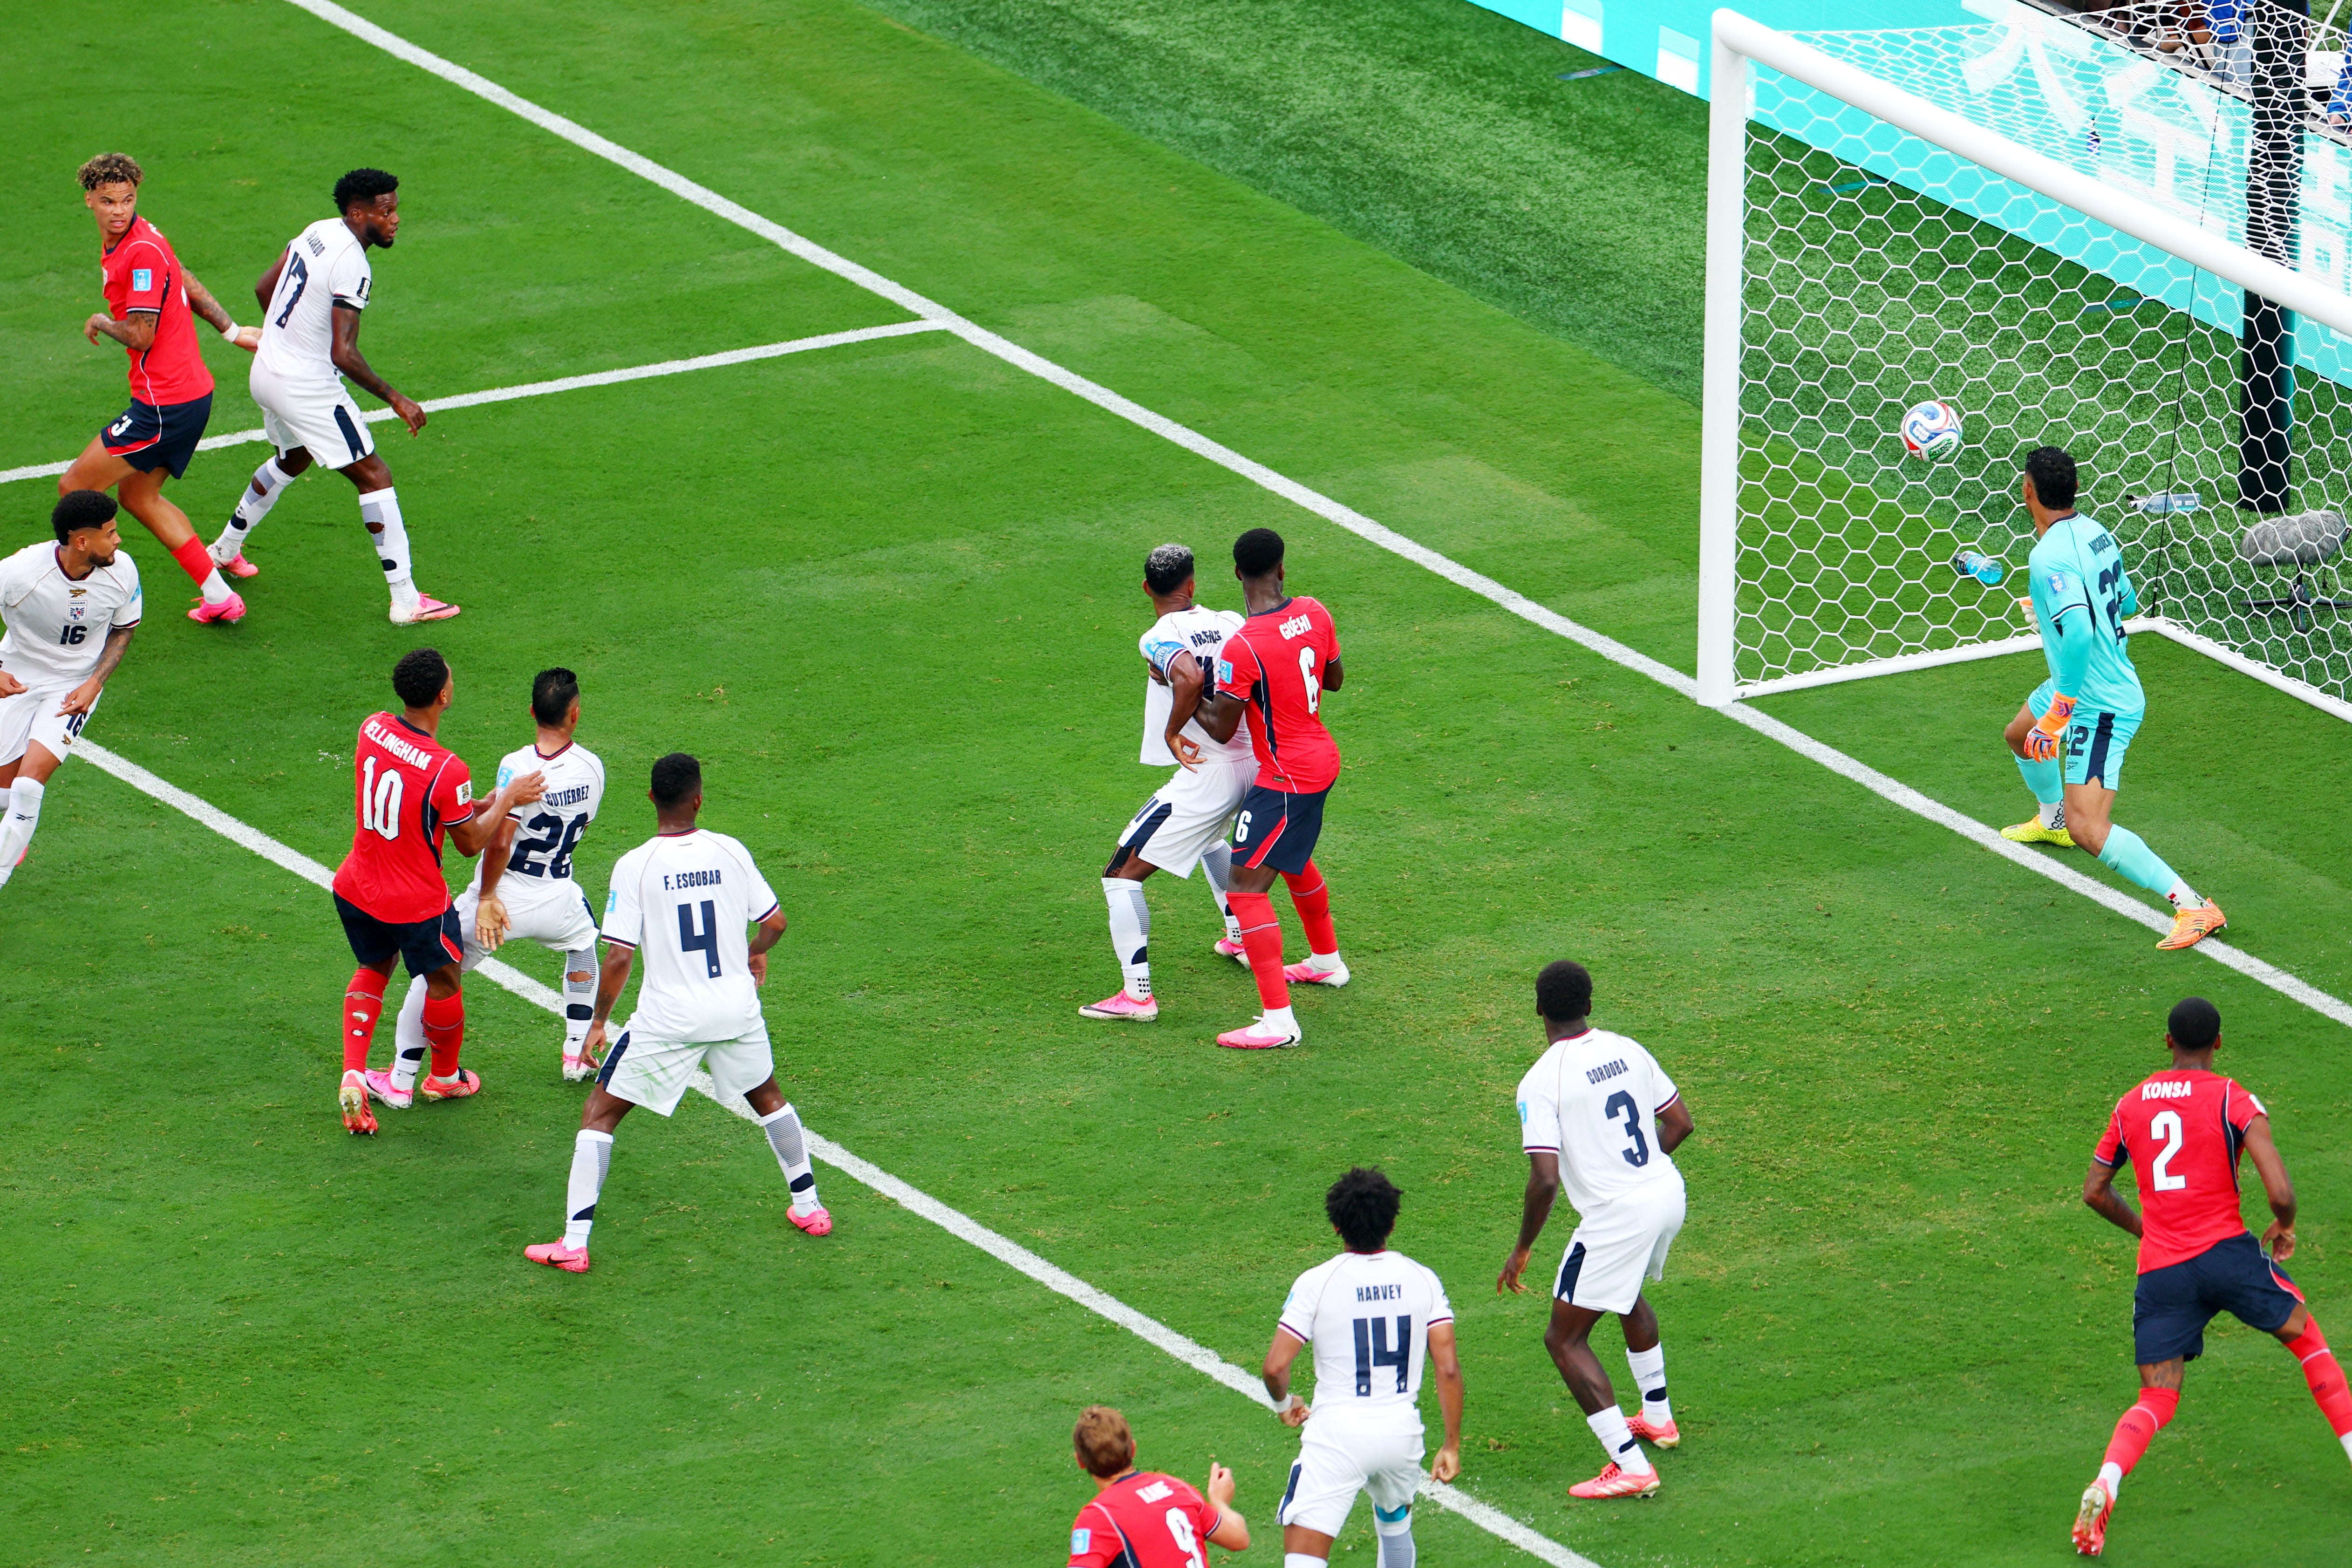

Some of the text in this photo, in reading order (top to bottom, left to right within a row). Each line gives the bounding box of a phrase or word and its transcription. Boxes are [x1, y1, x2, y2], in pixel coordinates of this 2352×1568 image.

[60, 625, 88, 645] 16
[1279, 614, 1312, 640] GUÉHI
[1196, 656, 1215, 702] 1
[1298, 646, 1320, 715] 6
[364, 720, 432, 770] BELLINGHAM
[362, 755, 404, 841] 10
[545, 785, 589, 807] GUTIÉRREZ
[506, 812, 588, 879] 26
[1235, 810, 1252, 843] 6
[664, 870, 722, 890] F. ESCOBAR
[677, 900, 722, 979] 4
[1586, 1058, 1629, 1085] CORDOBA
[2141, 1081, 2192, 1101] KONSA
[1605, 1090, 1649, 1168] 3
[2150, 1110, 2187, 1192] 2
[1357, 1284, 1401, 1302] HARVEY
[1353, 1315, 1411, 1397] 14
[1166, 1507, 1205, 1568] 9
